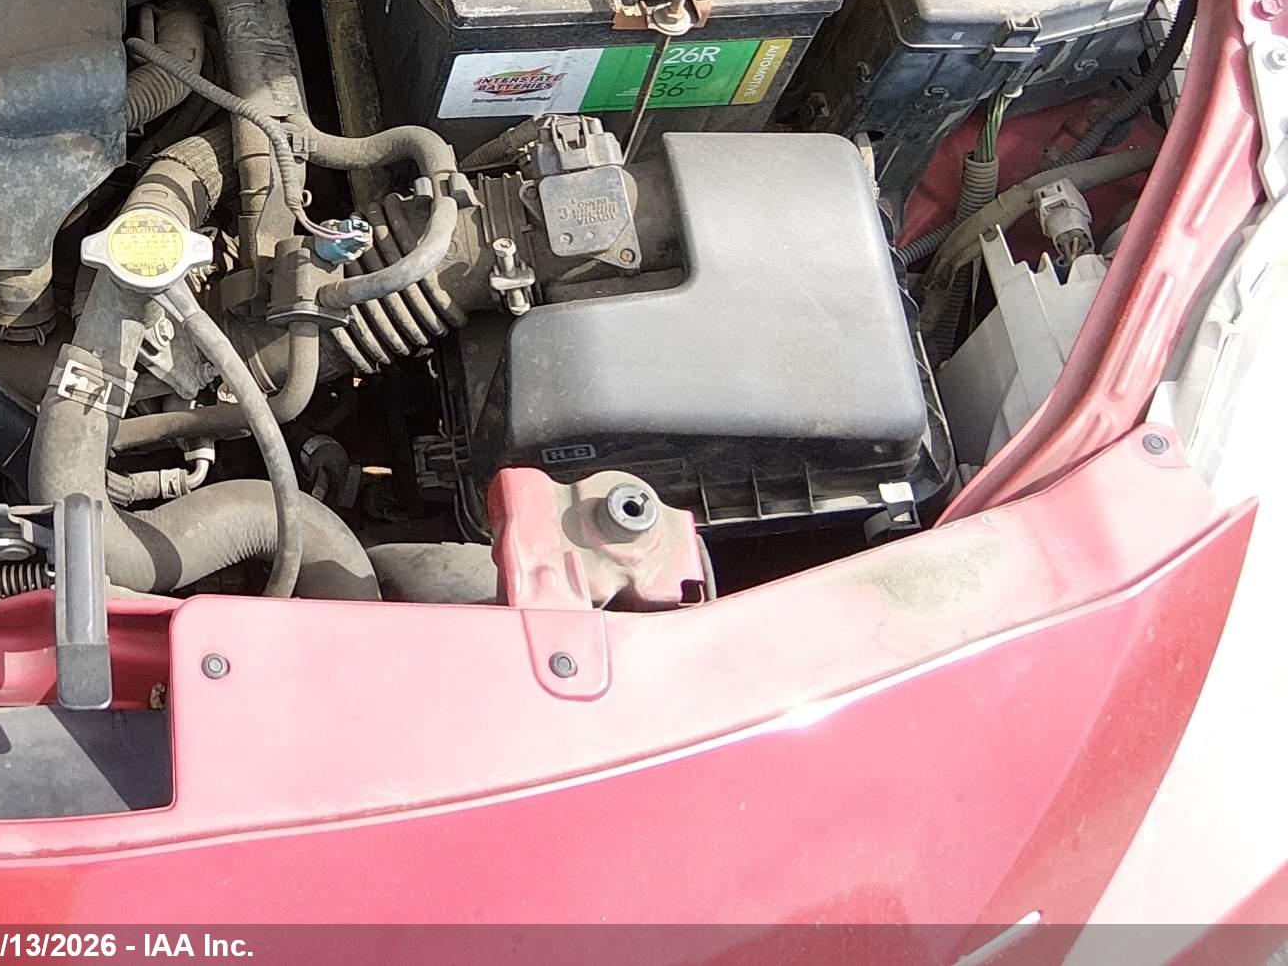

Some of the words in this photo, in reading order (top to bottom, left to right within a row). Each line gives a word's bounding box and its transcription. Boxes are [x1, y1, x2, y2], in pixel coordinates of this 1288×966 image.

[657, 63, 714, 81] 540
[744, 44, 781, 97] AUTOMOTIVE
[476, 74, 565, 85] INTERSTATE
[477, 82, 554, 91] BATTERIES
[575, 213, 617, 226] TOYOTA
[126, 262, 165, 270] CAUTION
